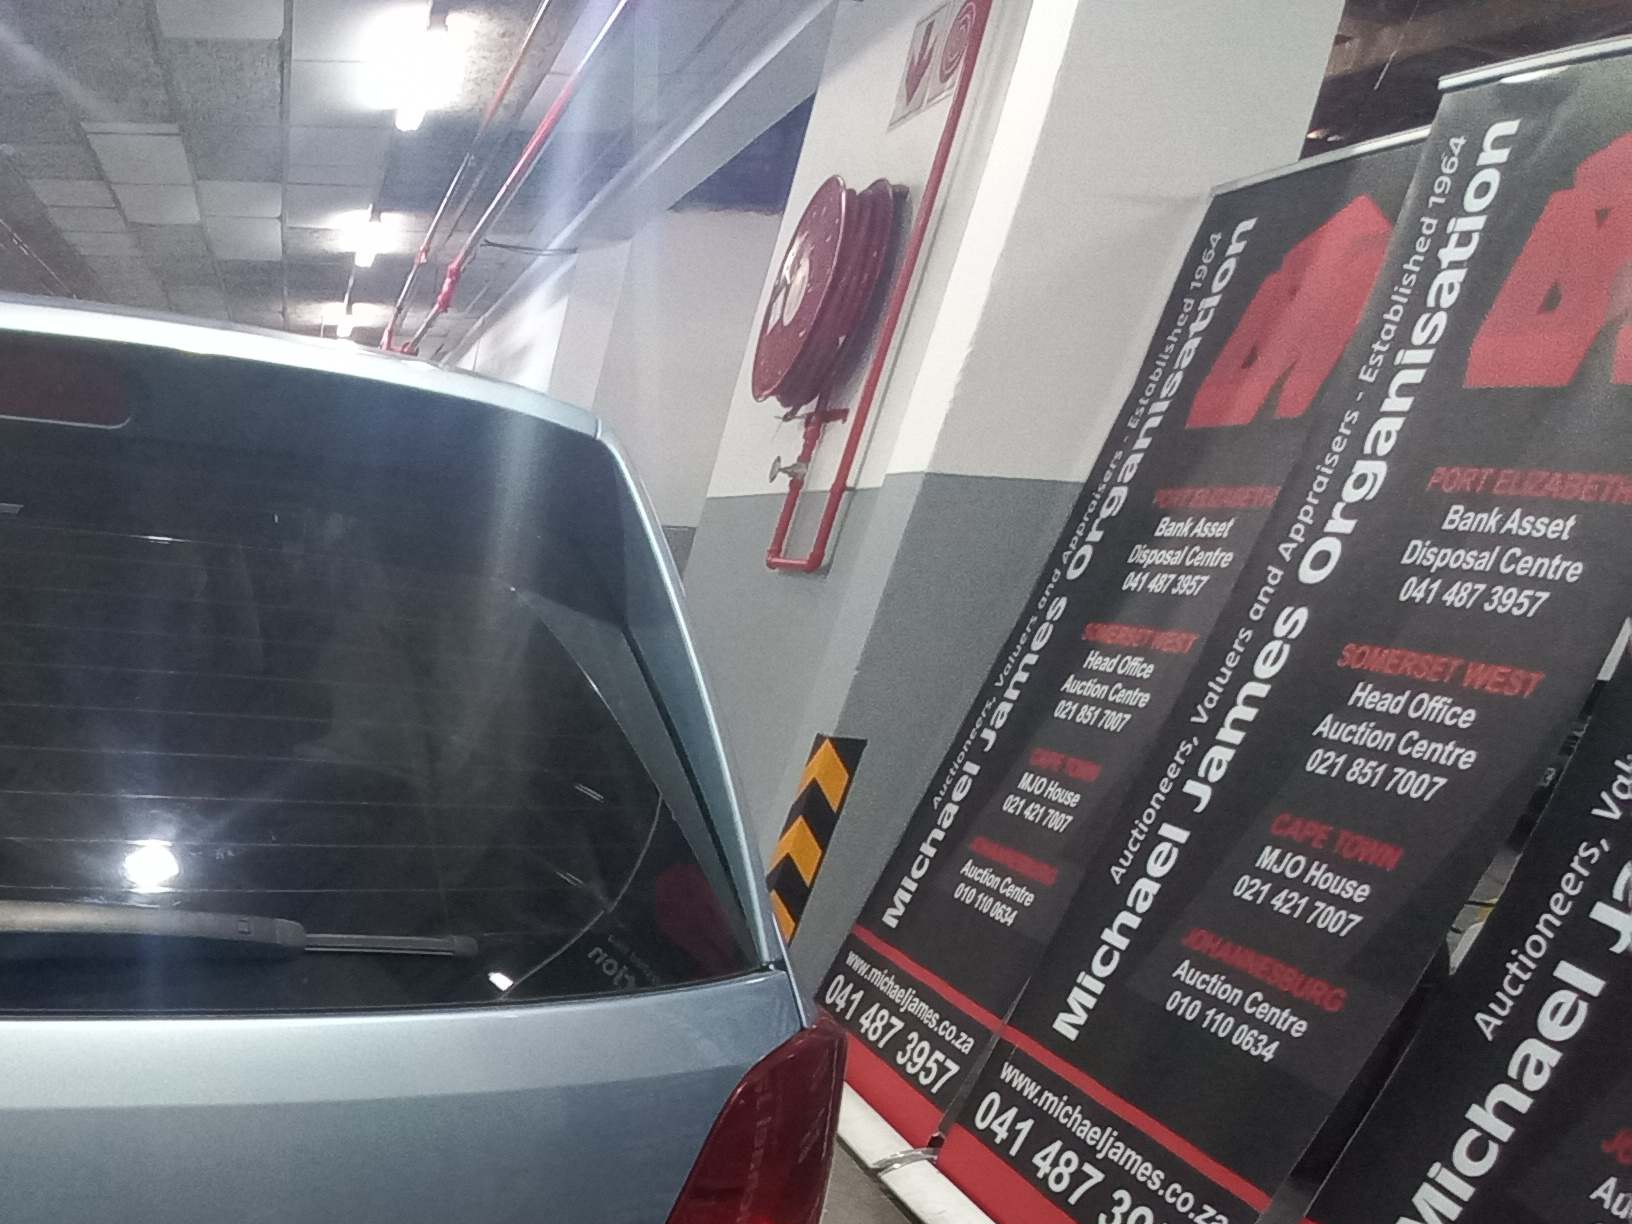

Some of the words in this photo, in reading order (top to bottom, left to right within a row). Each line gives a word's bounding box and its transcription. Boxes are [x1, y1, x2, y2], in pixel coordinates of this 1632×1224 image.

[1038, 568, 1061, 610] and
[1062, 451, 1123, 565] Appraisers
[1128, 298, 1195, 429] Established
[1190, 231, 1222, 290] 1964
[1109, 736, 1199, 885] Auctioneers,
[1187, 627, 1253, 724] Valuers
[1249, 565, 1284, 621] and
[1278, 409, 1359, 562] Appraisers
[1358, 216, 1438, 383] Established
[1428, 134, 1467, 209] 1964
[1153, 516, 1193, 539] Bank
[1190, 517, 1235, 539] Asset
[1441, 504, 1504, 534] Bank
[1501, 507, 1577, 541] Asset
[881, 761, 981, 928] Michael
[980, 596, 1068, 752] James
[1066, 217, 1258, 580] Organisation
[1051, 822, 1192, 1043] Michael
[1182, 606, 1309, 813] James
[1298, 118, 1522, 585] Organisation
[1127, 544, 1184, 569] Disposal
[1183, 547, 1234, 569] Centre
[1401, 539, 1501, 574] Disposal
[1499, 547, 1585, 583] Centre
[1121, 571, 1146, 592] 041
[1146, 573, 1174, 594] 487
[1171, 574, 1210, 596] 3957
[1398, 575, 1442, 606] 041
[1442, 581, 1486, 610] 487
[1483, 585, 1551, 619] 3957
[1083, 650, 1120, 674] Head
[1117, 654, 1155, 679] Office
[1462, 661, 1546, 698] WEST
[1053, 700, 1077, 720] 021
[1075, 703, 1100, 726] 851
[1099, 708, 1132, 732] 7007
[1060, 674, 1110, 701] Auction
[1108, 681, 1151, 709] Centre
[1347, 680, 1409, 716] Head
[1408, 692, 1477, 730] Office
[1311, 713, 1396, 753] Auction
[1396, 729, 1478, 770] Centre
[1017, 772, 1051, 798] MJO
[1046, 781, 1082, 808] House
[1305, 747, 1347, 778] 021
[1346, 754, 1390, 789] 851
[1388, 762, 1449, 802] 7007
[1002, 795, 1026, 817] 021
[1022, 800, 1045, 824] 421
[1043, 808, 1074, 834] 7007
[959, 858, 1002, 897] Auction
[999, 876, 1035, 907] Centre
[1255, 845, 1306, 879] MJO
[1304, 860, 1372, 904] House
[954, 883, 976, 907] 010
[973, 891, 995, 916] 110
[992, 900, 1019, 928] 0634
[1232, 874, 1273, 905] 021
[1269, 886, 1310, 922] 421
[1305, 898, 1364, 938] 7007
[1474, 838, 1610, 1042] Auctioneers,
[845, 949, 975, 1055] www.michaeljames.co.za
[1172, 959, 1244, 1007] Auction
[1243, 988, 1308, 1040] Centre
[824, 974, 863, 1021] 041
[859, 1005, 901, 1049] 487
[896, 1031, 960, 1095] 3957
[1166, 990, 1201, 1022] 010
[1201, 1004, 1235, 1041] 110
[1231, 1022, 1281, 1064] 0634
[974, 1091, 1034, 1157] 041
[1031, 1140, 1105, 1206] 487
